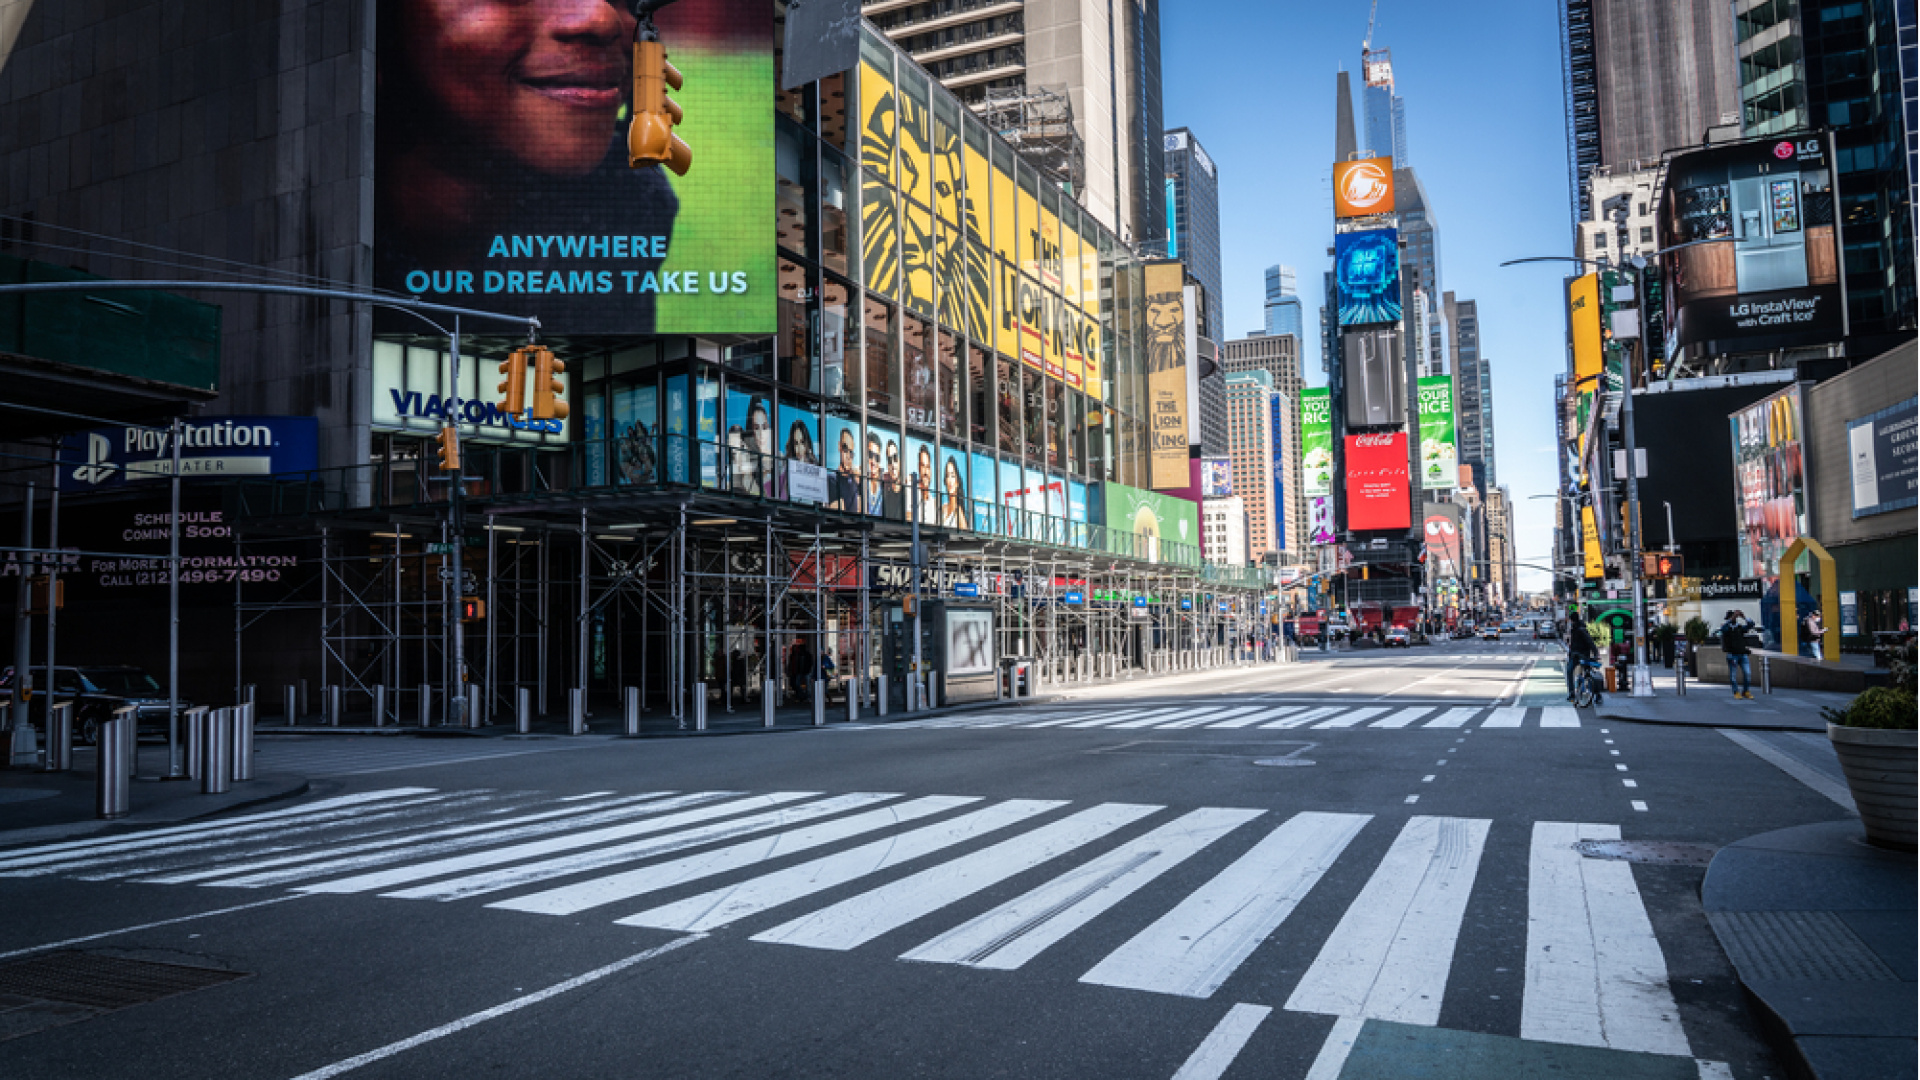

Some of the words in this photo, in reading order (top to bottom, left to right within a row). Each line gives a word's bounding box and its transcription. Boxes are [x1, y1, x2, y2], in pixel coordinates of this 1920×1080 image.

[1796, 139, 1819, 155] LG
[488, 235, 667, 258] ANYWHERE
[1030, 228, 1061, 278] THE
[406, 270, 475, 294] OUR
[484, 270, 613, 294] DREAMS
[622, 271, 698, 294] TAKE
[709, 270, 748, 294] US
[1000, 249, 1049, 335] LION
[1729, 304, 1749, 317] LG
[1737, 318, 1757, 328] with
[1758, 311, 1792, 325] Craft
[1418, 391, 1449, 402] OUR
[1156, 400, 1178, 411] THE
[1303, 402, 1329, 413] YOU
[1153, 413, 1182, 430] LION
[1303, 412, 1330, 425] RIC
[1152, 431, 1186, 451] KING
[153, 460, 224, 473] THATER
[134, 511, 224, 526] SCHEDULE
[122, 527, 181, 542] COMIN
[91, 560, 116, 573] FOR
[118, 558, 158, 572] MORE
[162, 555, 298, 569] IFORMATION
[99, 574, 134, 587] CALL
[135, 571, 177, 586] (212
[179, 568, 281, 584] 496-7490
[876, 566, 970, 590] SKCHERS
[1738, 580, 1758, 593] hut
